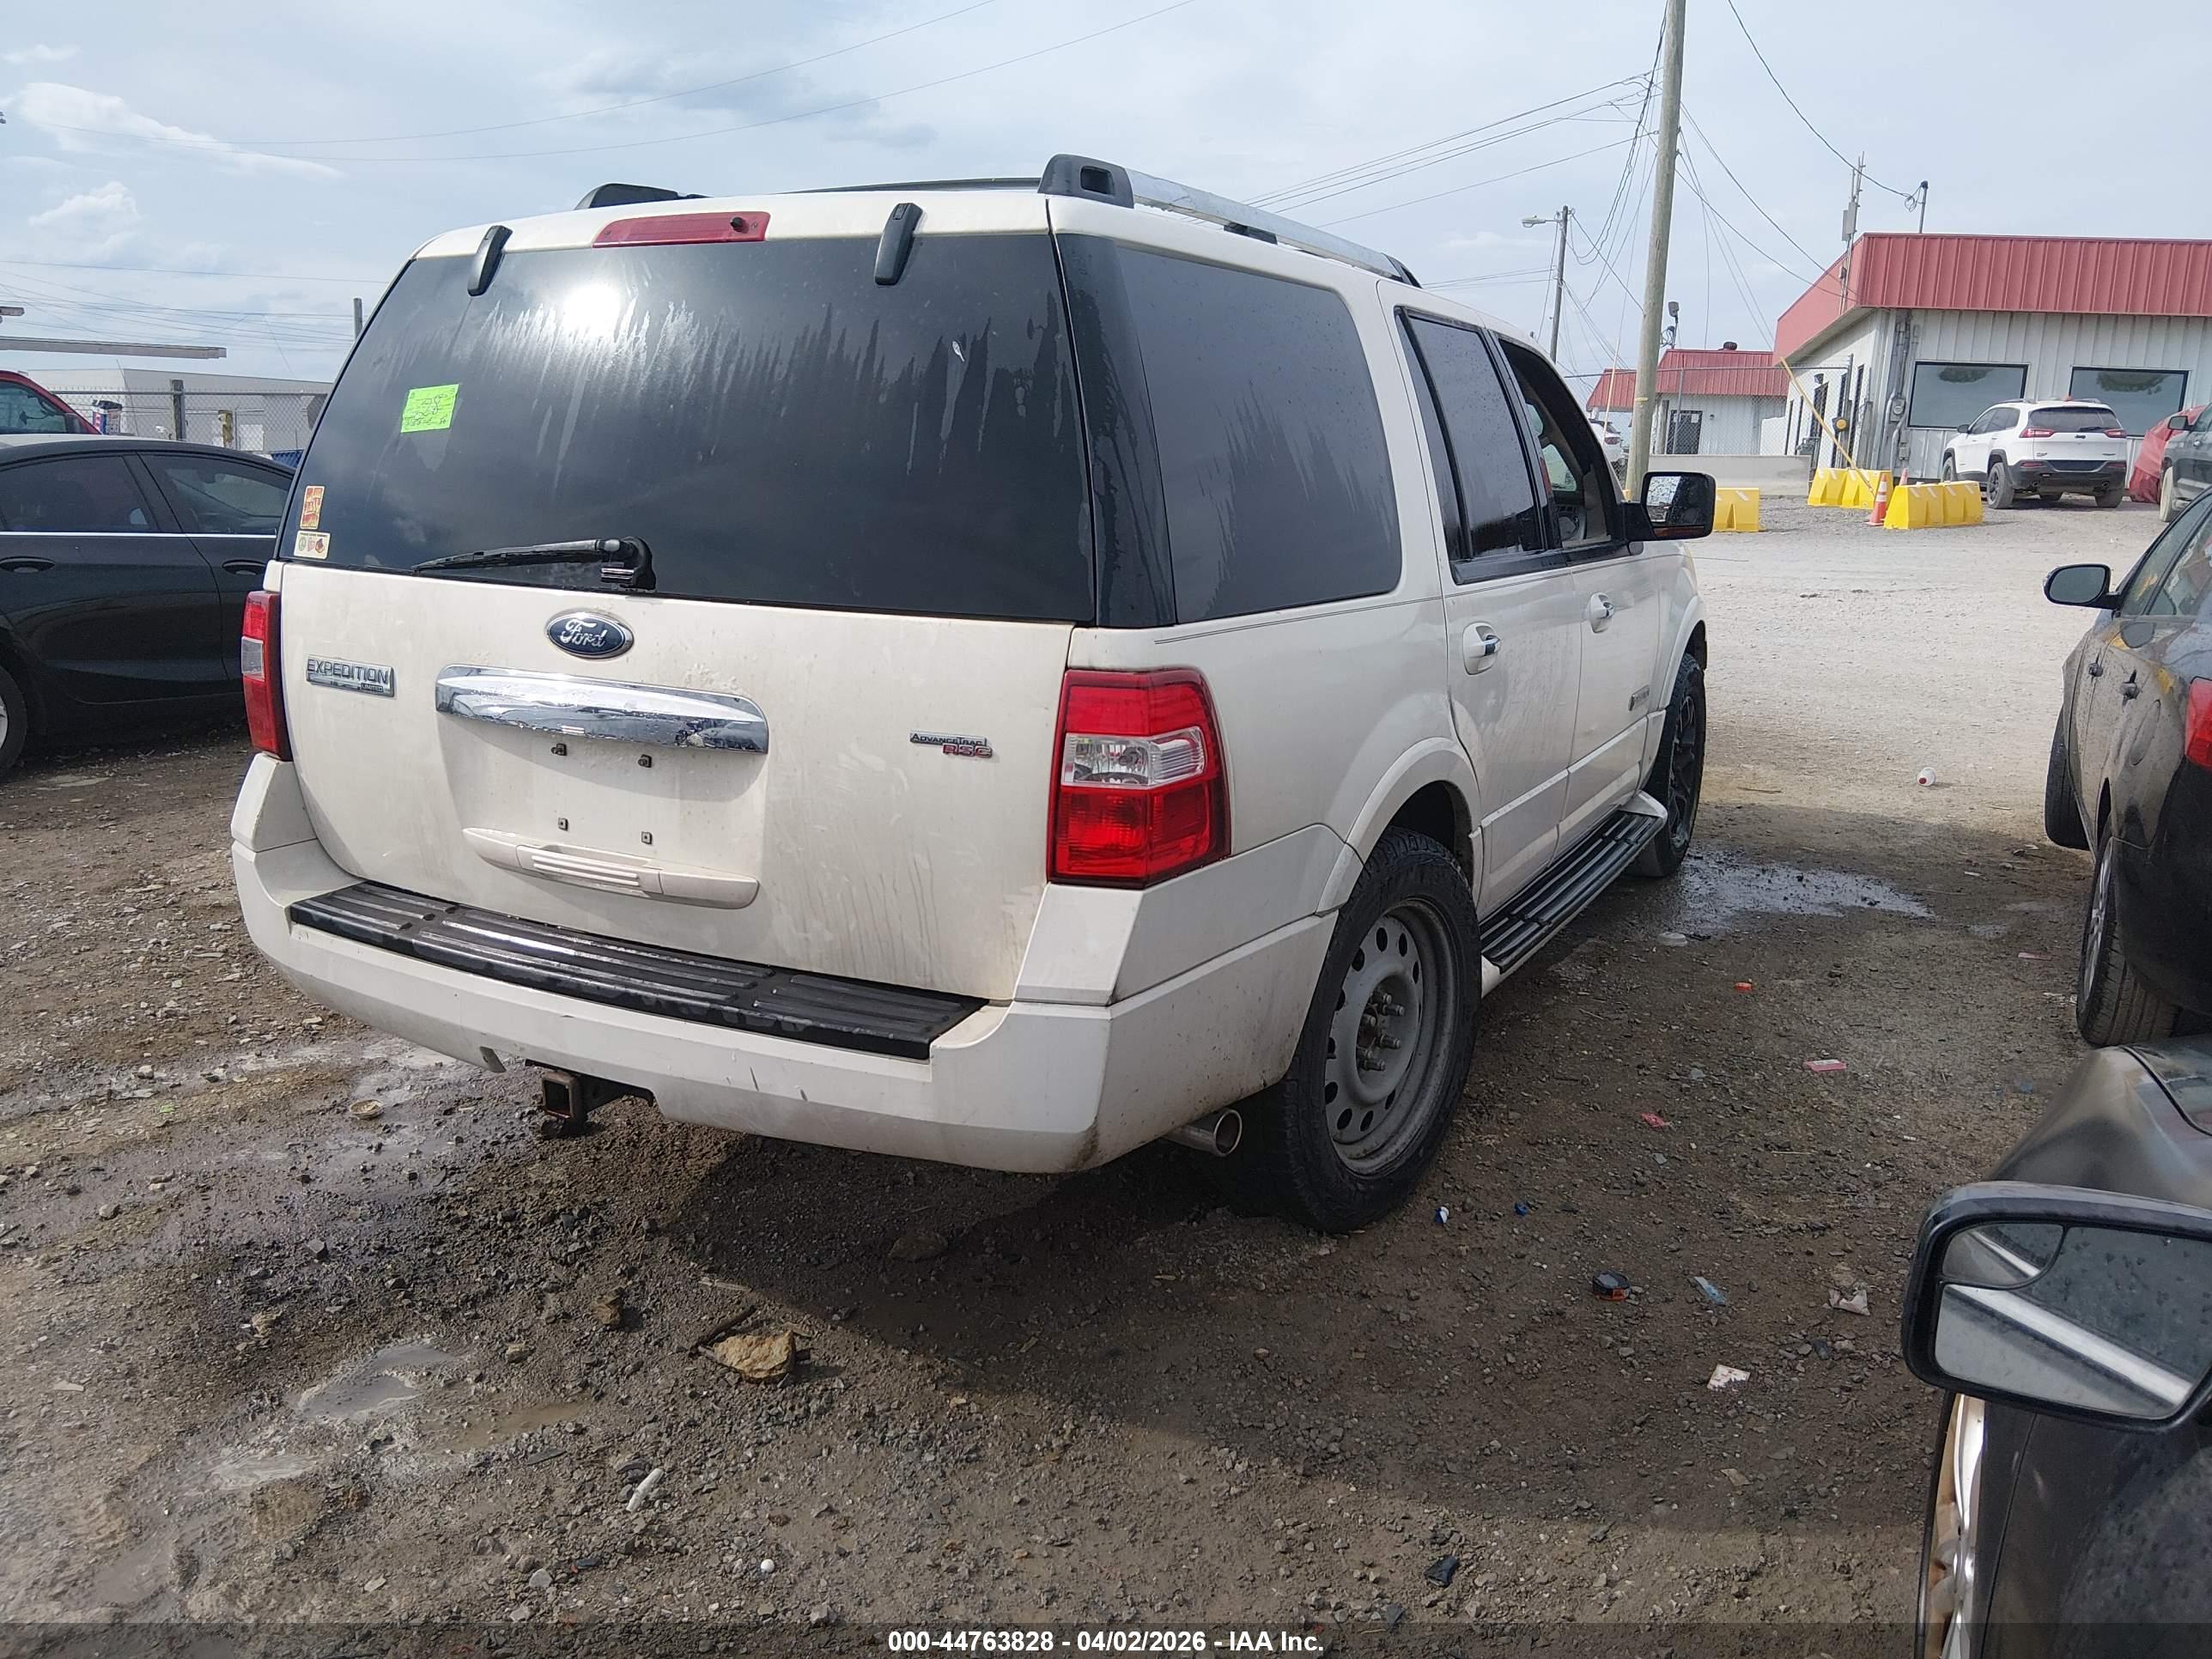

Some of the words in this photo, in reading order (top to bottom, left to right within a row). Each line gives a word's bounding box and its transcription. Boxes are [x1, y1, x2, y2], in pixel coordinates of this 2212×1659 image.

[560, 618, 608, 647] Ford
[307, 659, 389, 684] EXPEDITION
[943, 744, 993, 758] RSC
